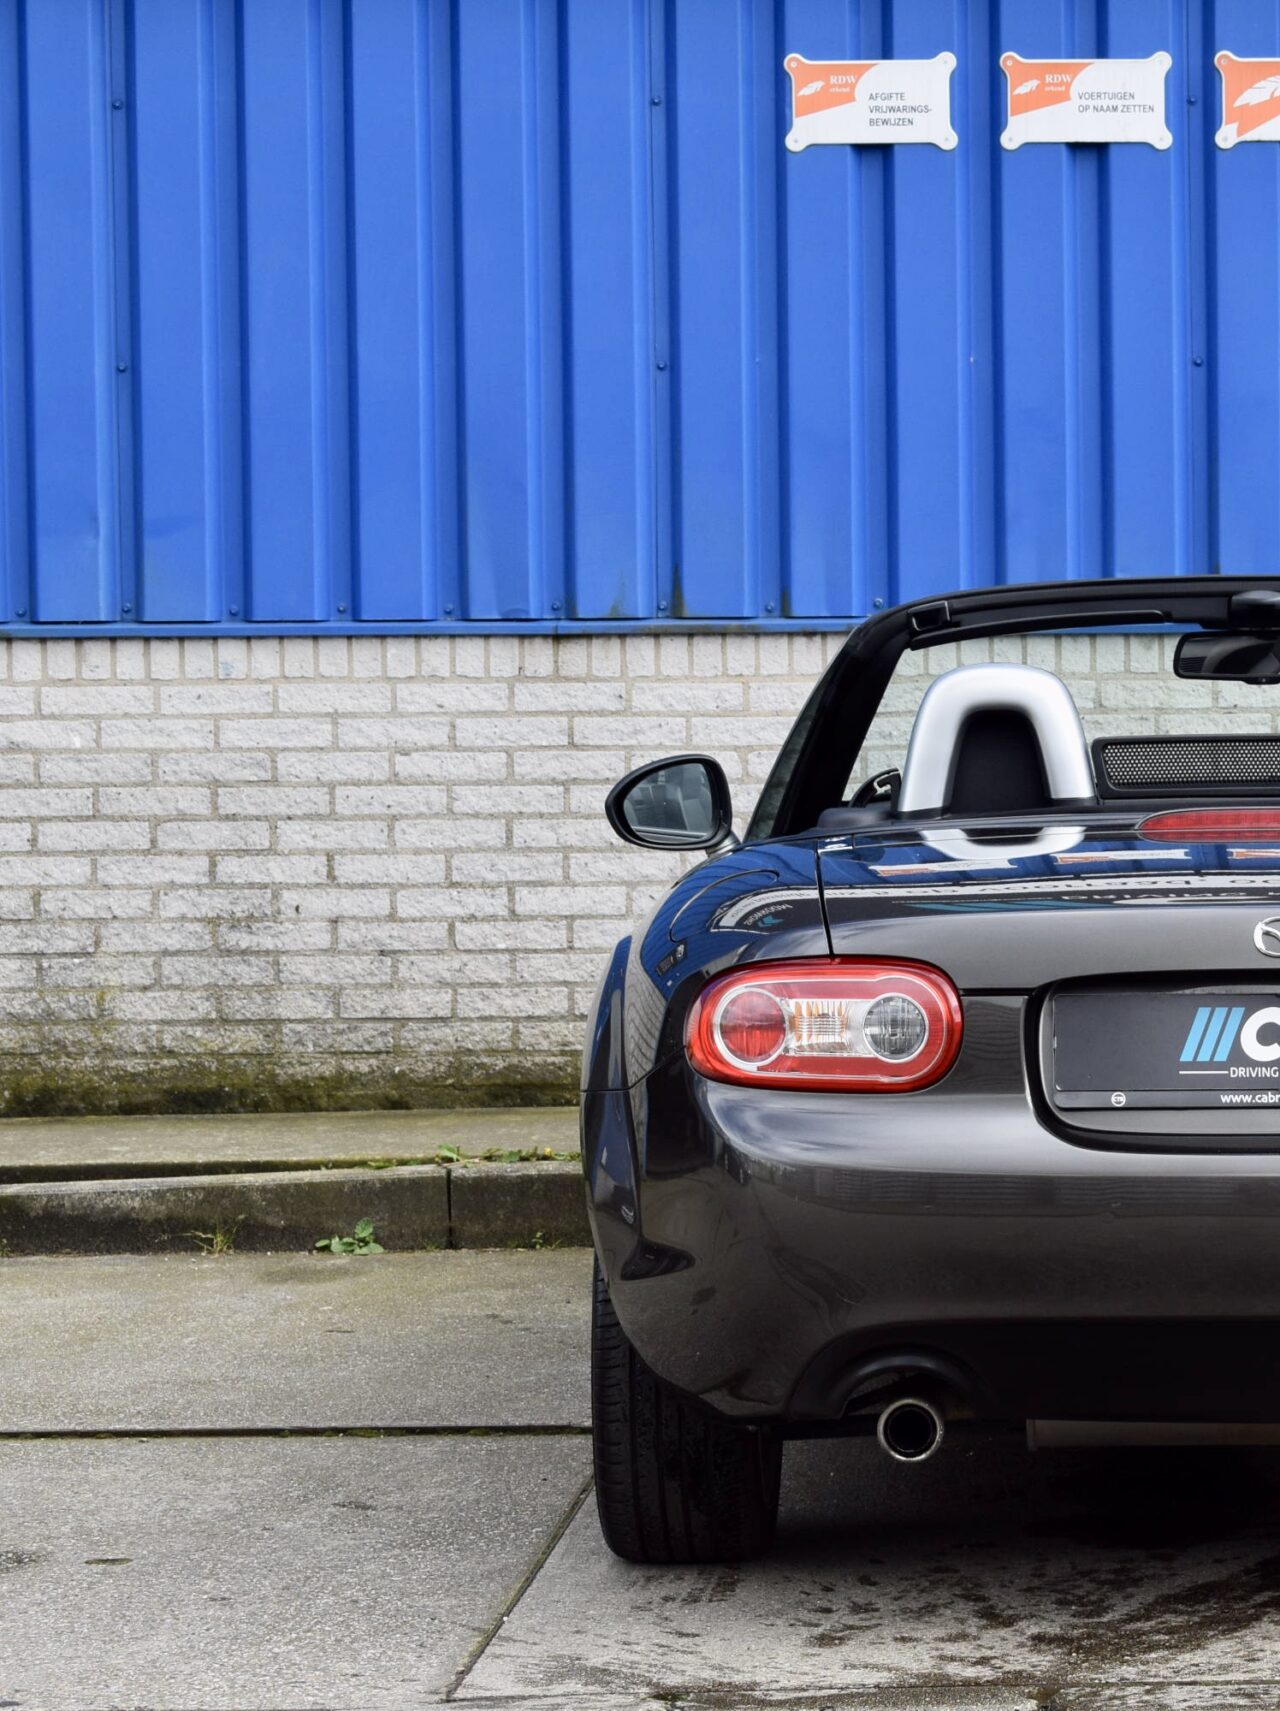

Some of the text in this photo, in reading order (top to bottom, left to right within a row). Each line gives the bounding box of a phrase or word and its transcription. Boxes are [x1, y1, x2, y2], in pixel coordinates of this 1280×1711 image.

[829, 75, 858, 84] RDW
[1044, 73, 1073, 83] RDW
[868, 92, 906, 101] AFGIFTE
[1078, 91, 1135, 100] VOERTUIGEN
[868, 105, 933, 114] VRIJWARINGS-
[1078, 104, 1155, 113] OP NAAM ZETTEN
[868, 118, 914, 126] BEWIJZEN
[1229, 1066, 1279, 1079] DRIVING
